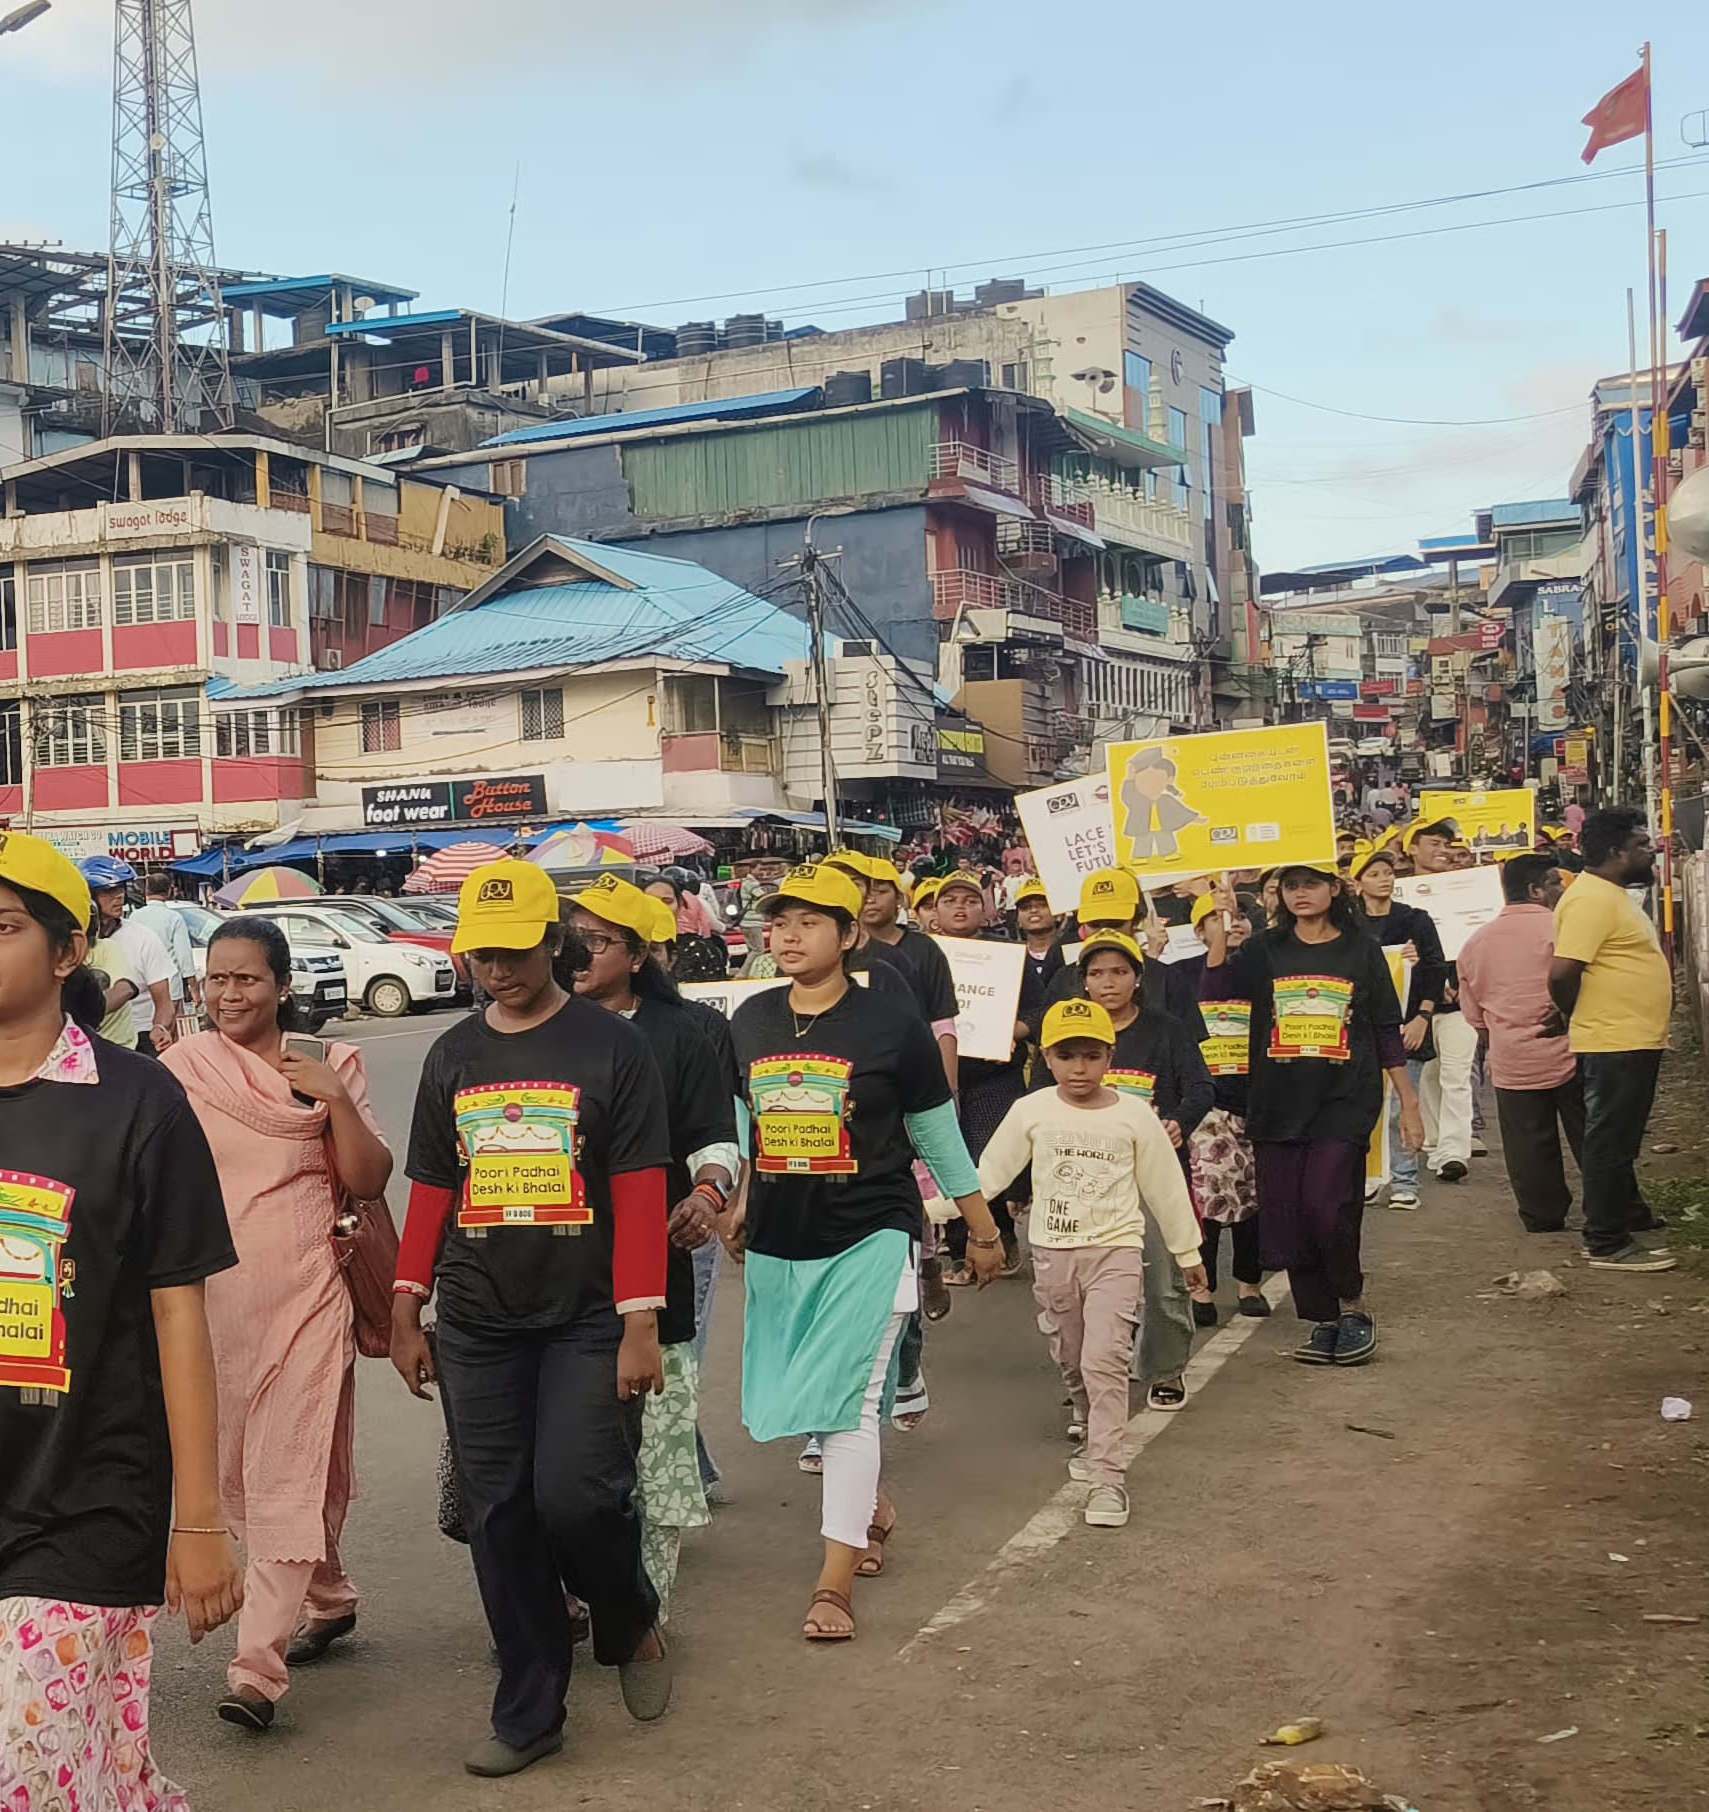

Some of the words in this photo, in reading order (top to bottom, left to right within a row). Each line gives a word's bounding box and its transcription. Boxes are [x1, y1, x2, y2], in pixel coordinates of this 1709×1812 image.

[109, 513, 151, 531] swagat
[155, 510, 187, 528] lodge
[239, 547, 252, 612] SWAGAT
[463, 780, 531, 805] Button
[366, 804, 400, 824] foot
[404, 804, 448, 820] wear
[471, 798, 533, 819] House
[107, 830, 172, 847] MOBILE
[1064, 827, 1105, 847] LACE
[108, 846, 173, 862] WORLD
[1068, 843, 1107, 862] LET'S
[765, 1123, 791, 1135] Poori
[793, 1122, 832, 1134] Padhai
[764, 1136, 787, 1148] Desh
[789, 1135, 799, 1147] ki
[800, 1135, 836, 1148] Bhalai
[1054, 1147, 1075, 1157] THE
[1076, 1148, 1115, 1162] WORLD
[474, 1164, 509, 1179] Poori
[511, 1163, 561, 1179] Padhai
[472, 1181, 504, 1195] Desh
[507, 1180, 520, 1194] ki
[522, 1179, 566, 1195] Bhalai
[1048, 1198, 1070, 1216] ONE
[1046, 1215, 1080, 1233] GAME
